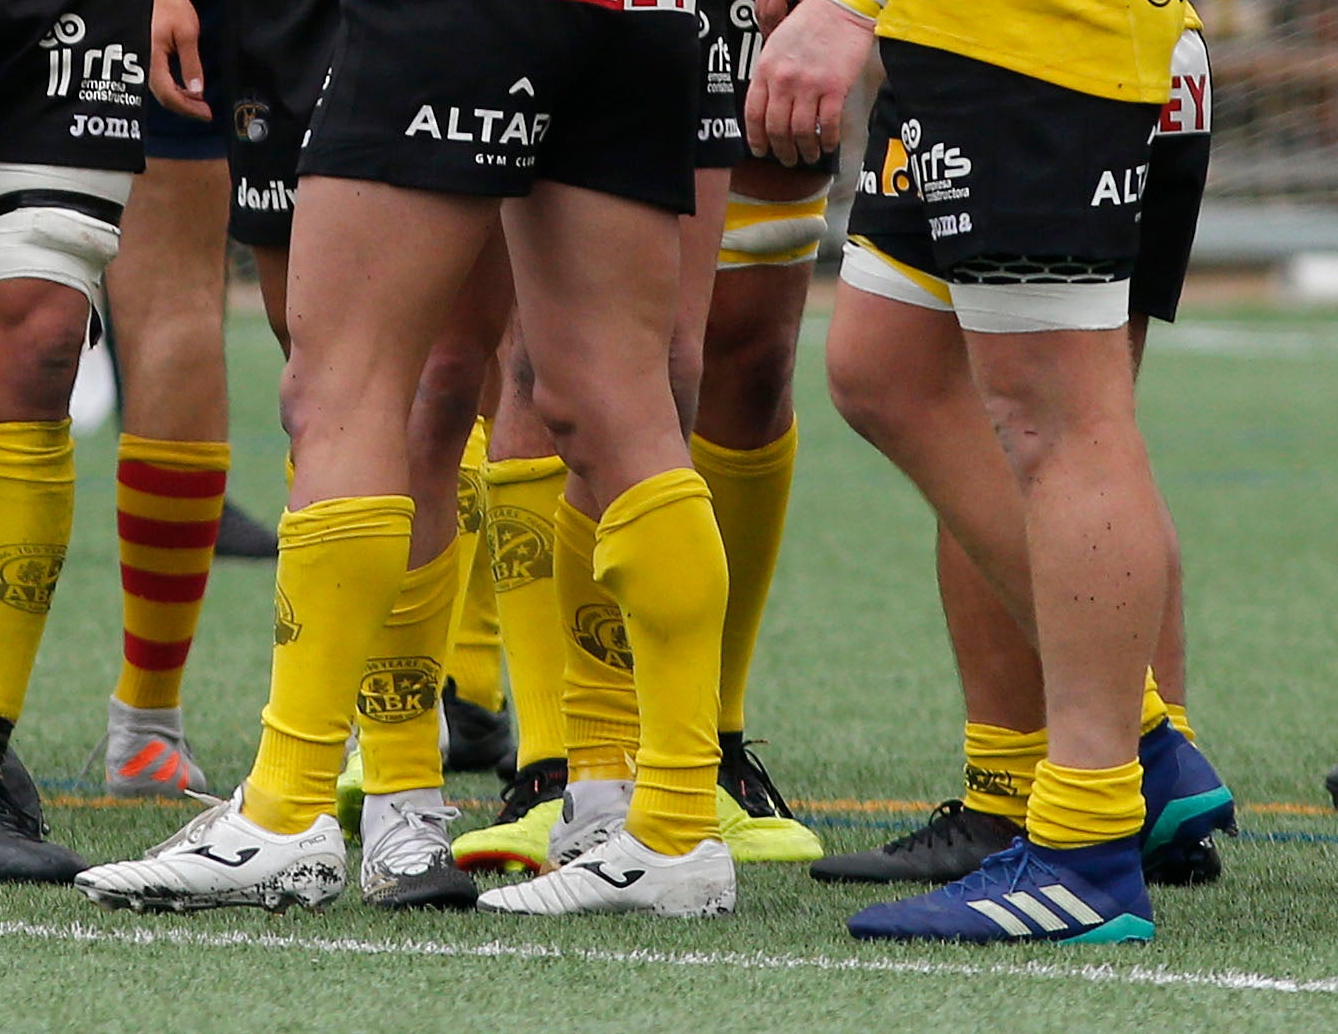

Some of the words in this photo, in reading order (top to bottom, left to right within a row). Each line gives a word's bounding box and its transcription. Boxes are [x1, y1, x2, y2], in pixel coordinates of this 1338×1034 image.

[83, 43, 146, 85] rfs
[474, 152, 508, 167] GYM
[365, 694, 423, 713] ABK
